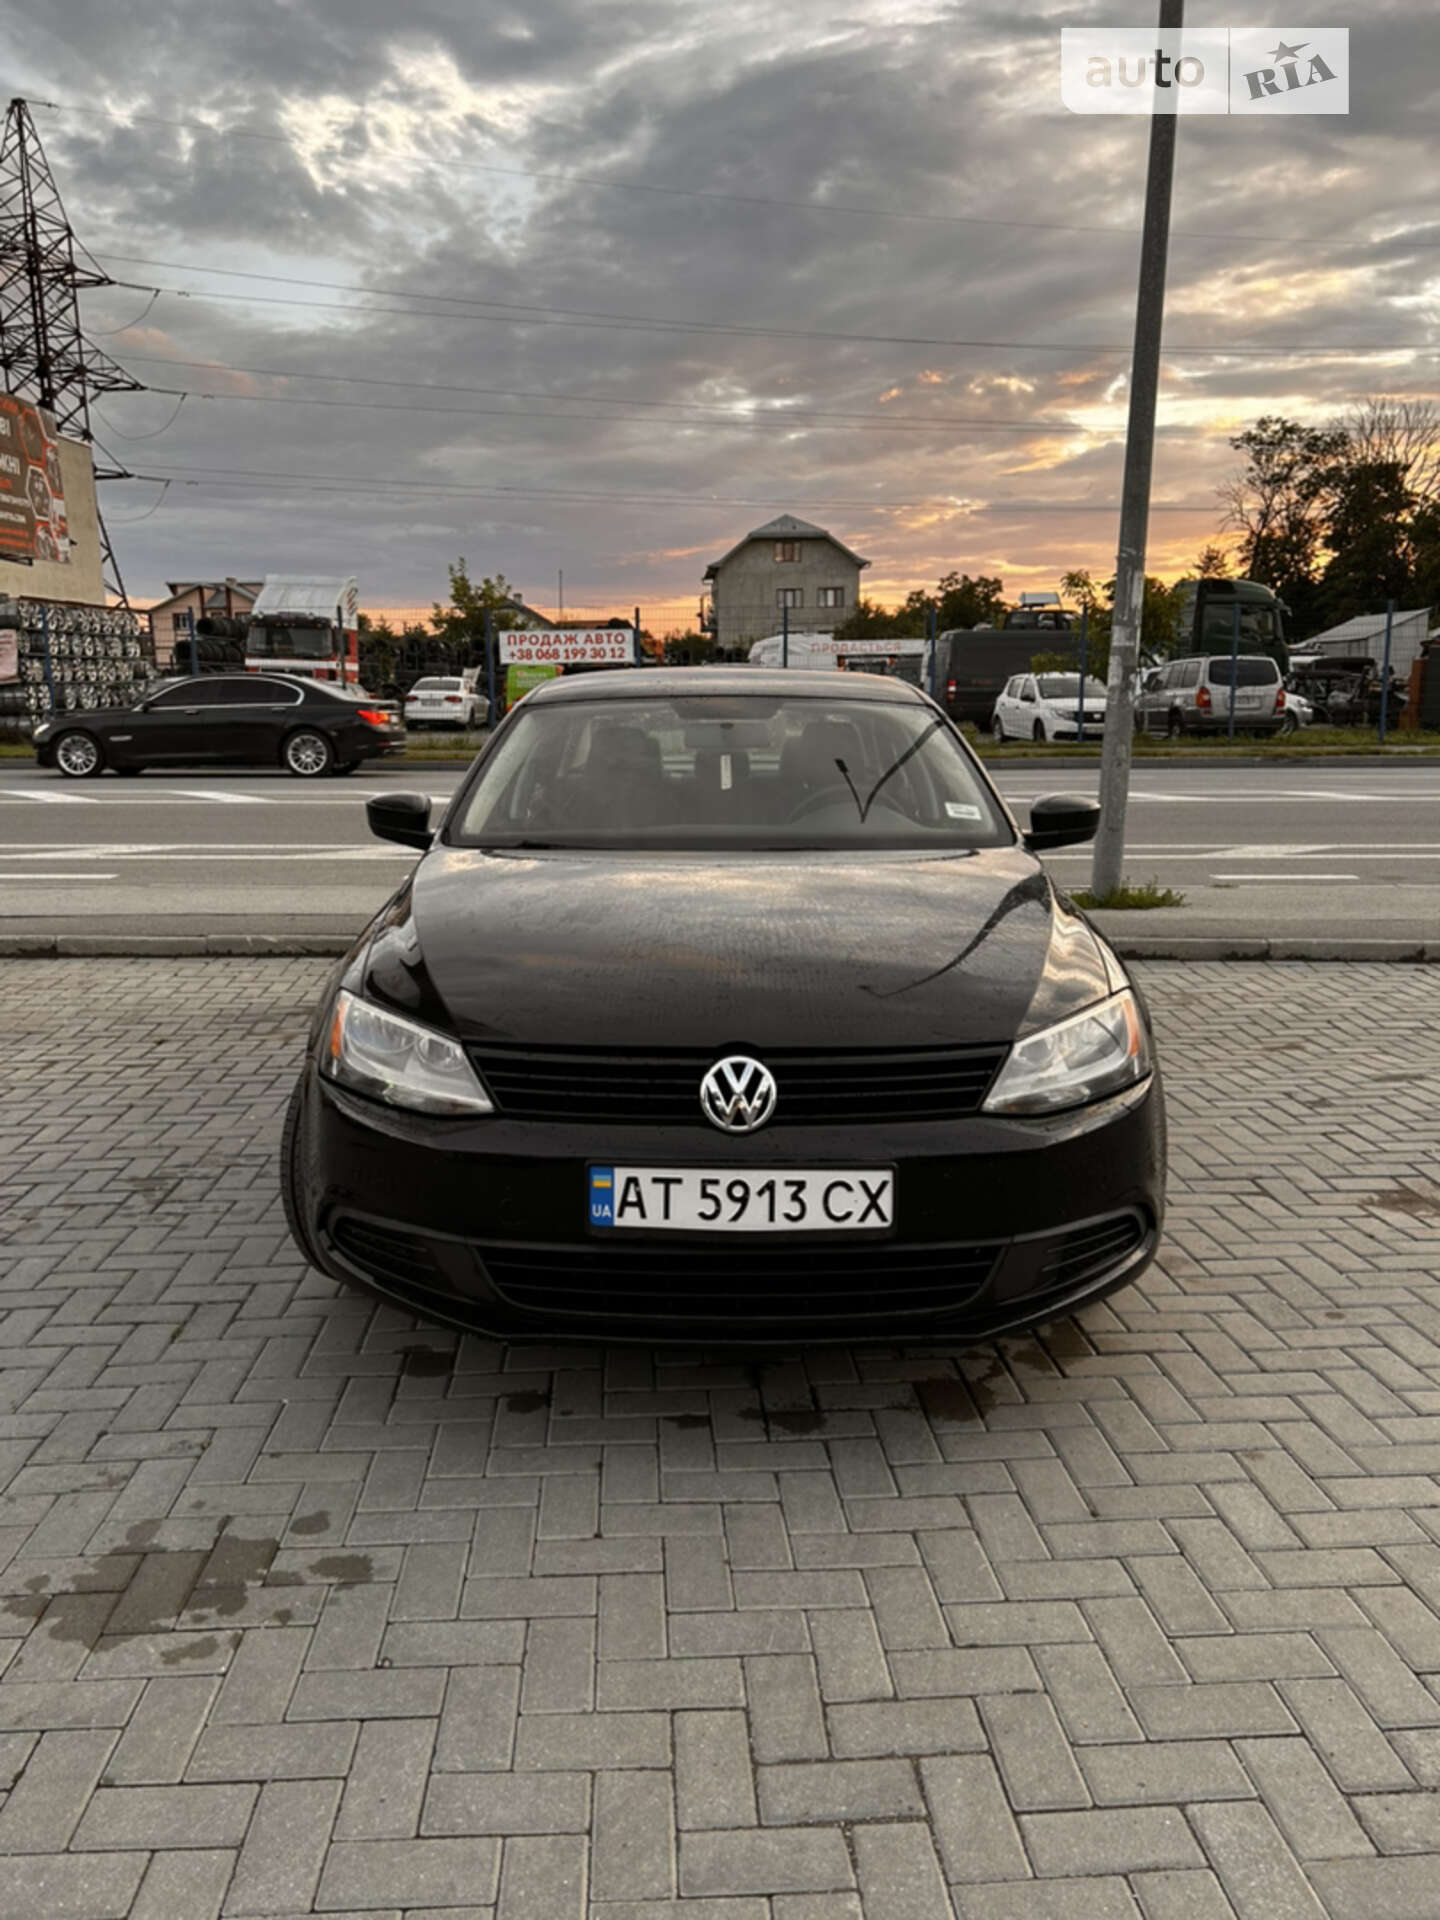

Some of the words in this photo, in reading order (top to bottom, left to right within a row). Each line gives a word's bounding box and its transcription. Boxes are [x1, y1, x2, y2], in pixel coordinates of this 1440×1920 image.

[507, 633, 578, 647] ПРОДАЖ
[584, 632, 626, 645] АВТО
[509, 649, 533, 660] +38
[535, 648, 560, 660] 068
[564, 647, 587, 659] 199
[590, 647, 606, 659] 30
[610, 646, 625, 658] 12
[616, 1176, 684, 1220] AT
[697, 1178, 807, 1223] 5913
[822, 1179, 890, 1223] CX
[591, 1203, 613, 1218] UA
